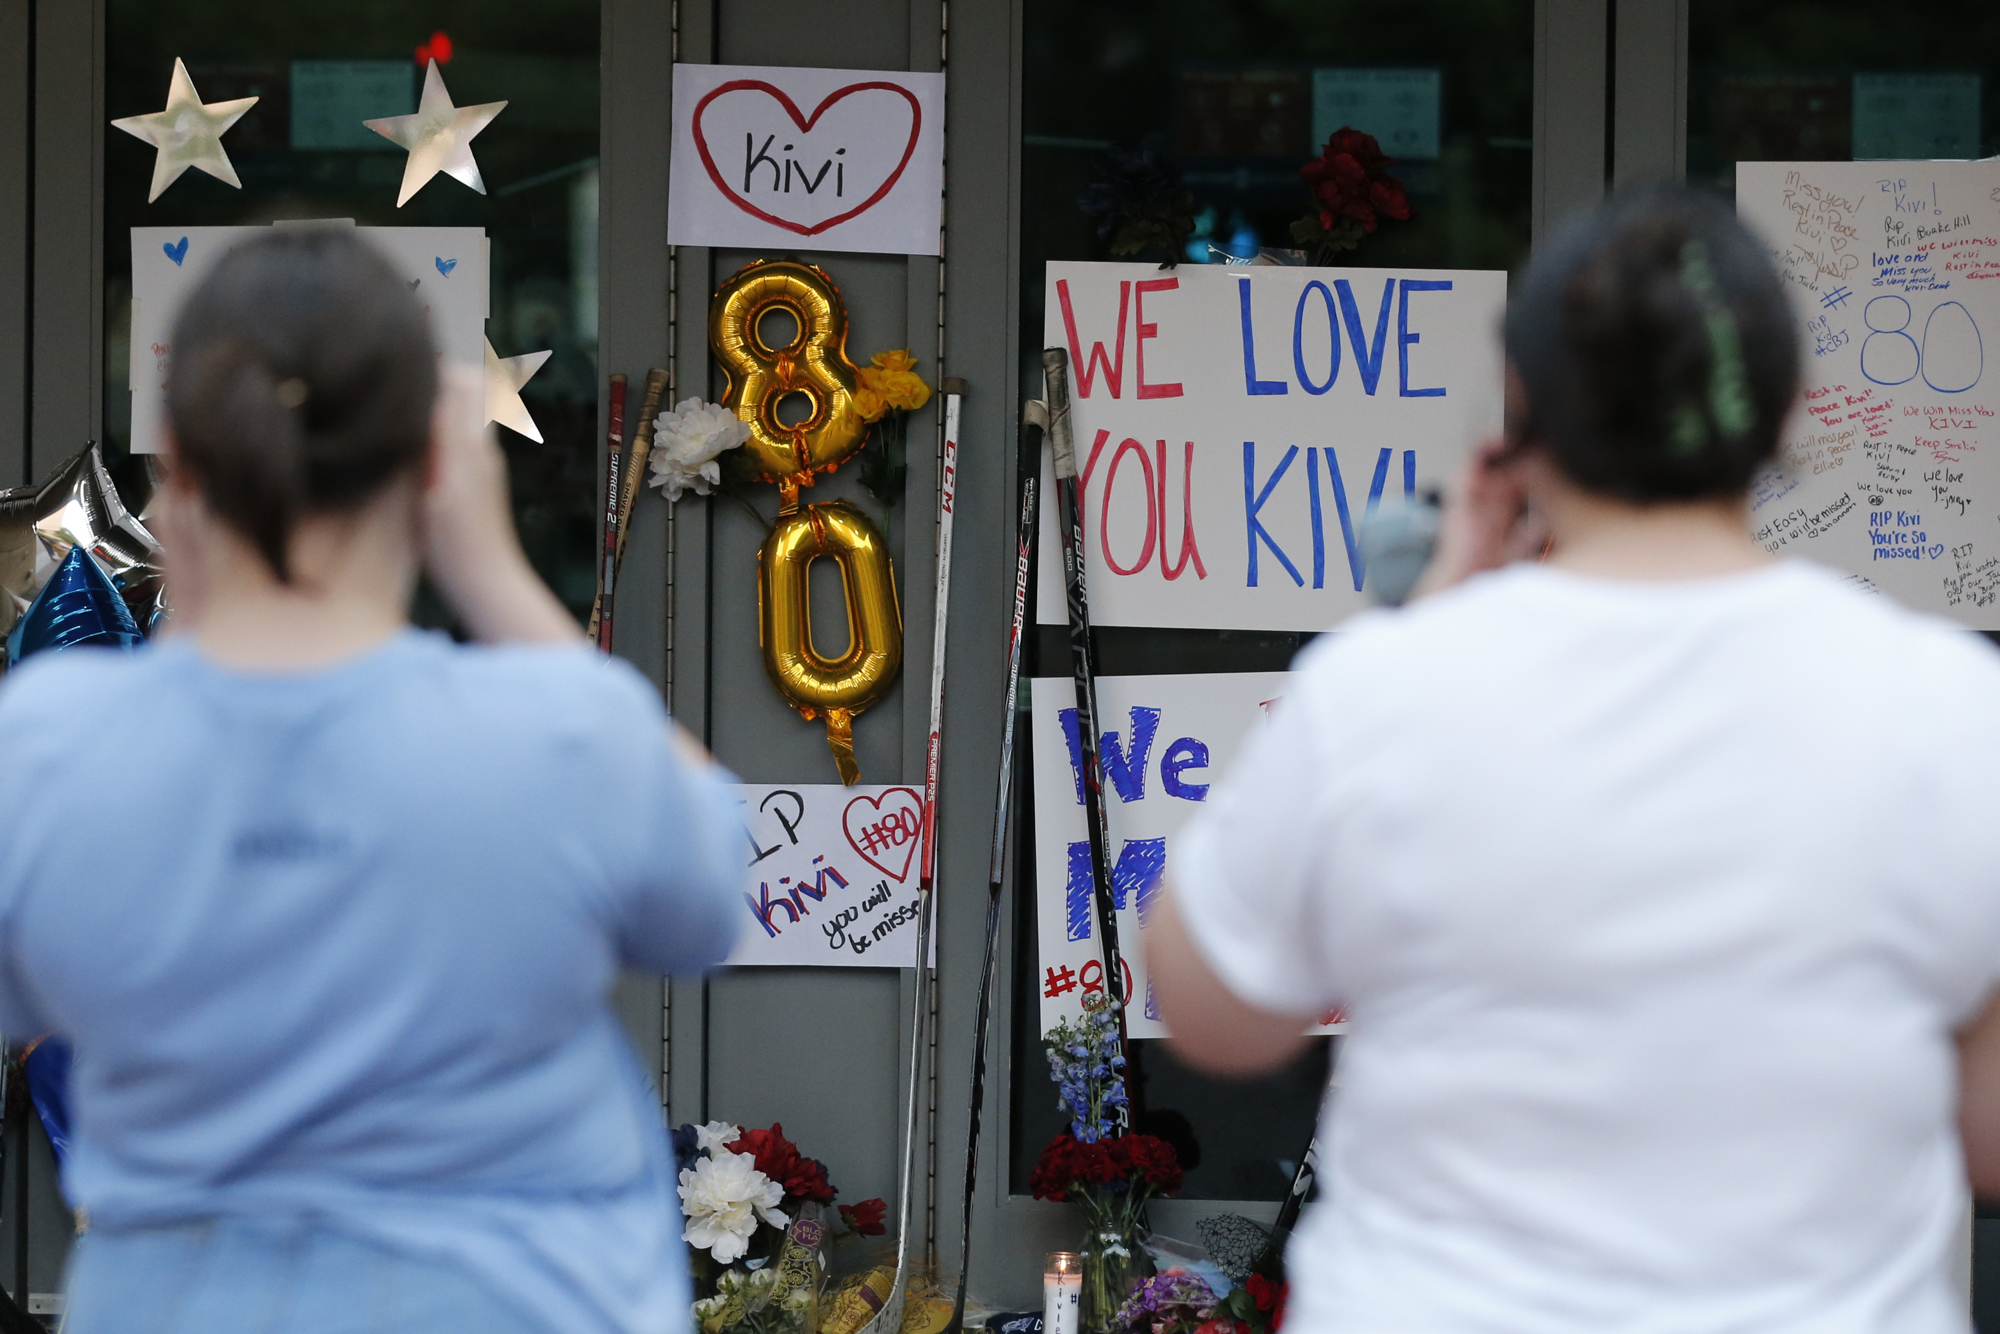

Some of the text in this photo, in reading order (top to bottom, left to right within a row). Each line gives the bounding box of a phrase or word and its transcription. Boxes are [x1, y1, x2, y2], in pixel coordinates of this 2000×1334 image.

[744, 132, 846, 197] Kivi
[1785, 170, 1821, 200] Miss
[1876, 179, 1906, 193] RIP
[1783, 190, 1811, 217] Rest
[1795, 216, 1825, 244] Kivi
[1873, 252, 1929, 267] love and
[1910, 267, 1932, 278] you
[1056, 277, 1453, 400] WE LOVE
[1928, 416, 1978, 430] KIVI
[1949, 406, 1972, 415] Miss
[1974, 404, 1995, 417] You
[1914, 436, 1940, 450] Keep
[943, 439, 957, 514] CCM
[1946, 468, 1963, 483] love
[1876, 484, 1893, 494] love
[1896, 488, 1912, 497] you
[1932, 485, 1949, 503] you
[1072, 428, 1208, 581] YOU
[1821, 492, 1851, 519] missed
[1870, 509, 1921, 527] RIP Kivi
[1868, 528, 1907, 545] You're
[1873, 544, 1925, 561] missed!
[929, 738, 939, 781] PREMIER
[1058, 706, 1210, 805] We
[743, 789, 804, 867] IP
[859, 806, 920, 856] #80
[743, 854, 849, 938] Kivi
[822, 880, 892, 949] you will
[848, 887, 920, 954] be misse
